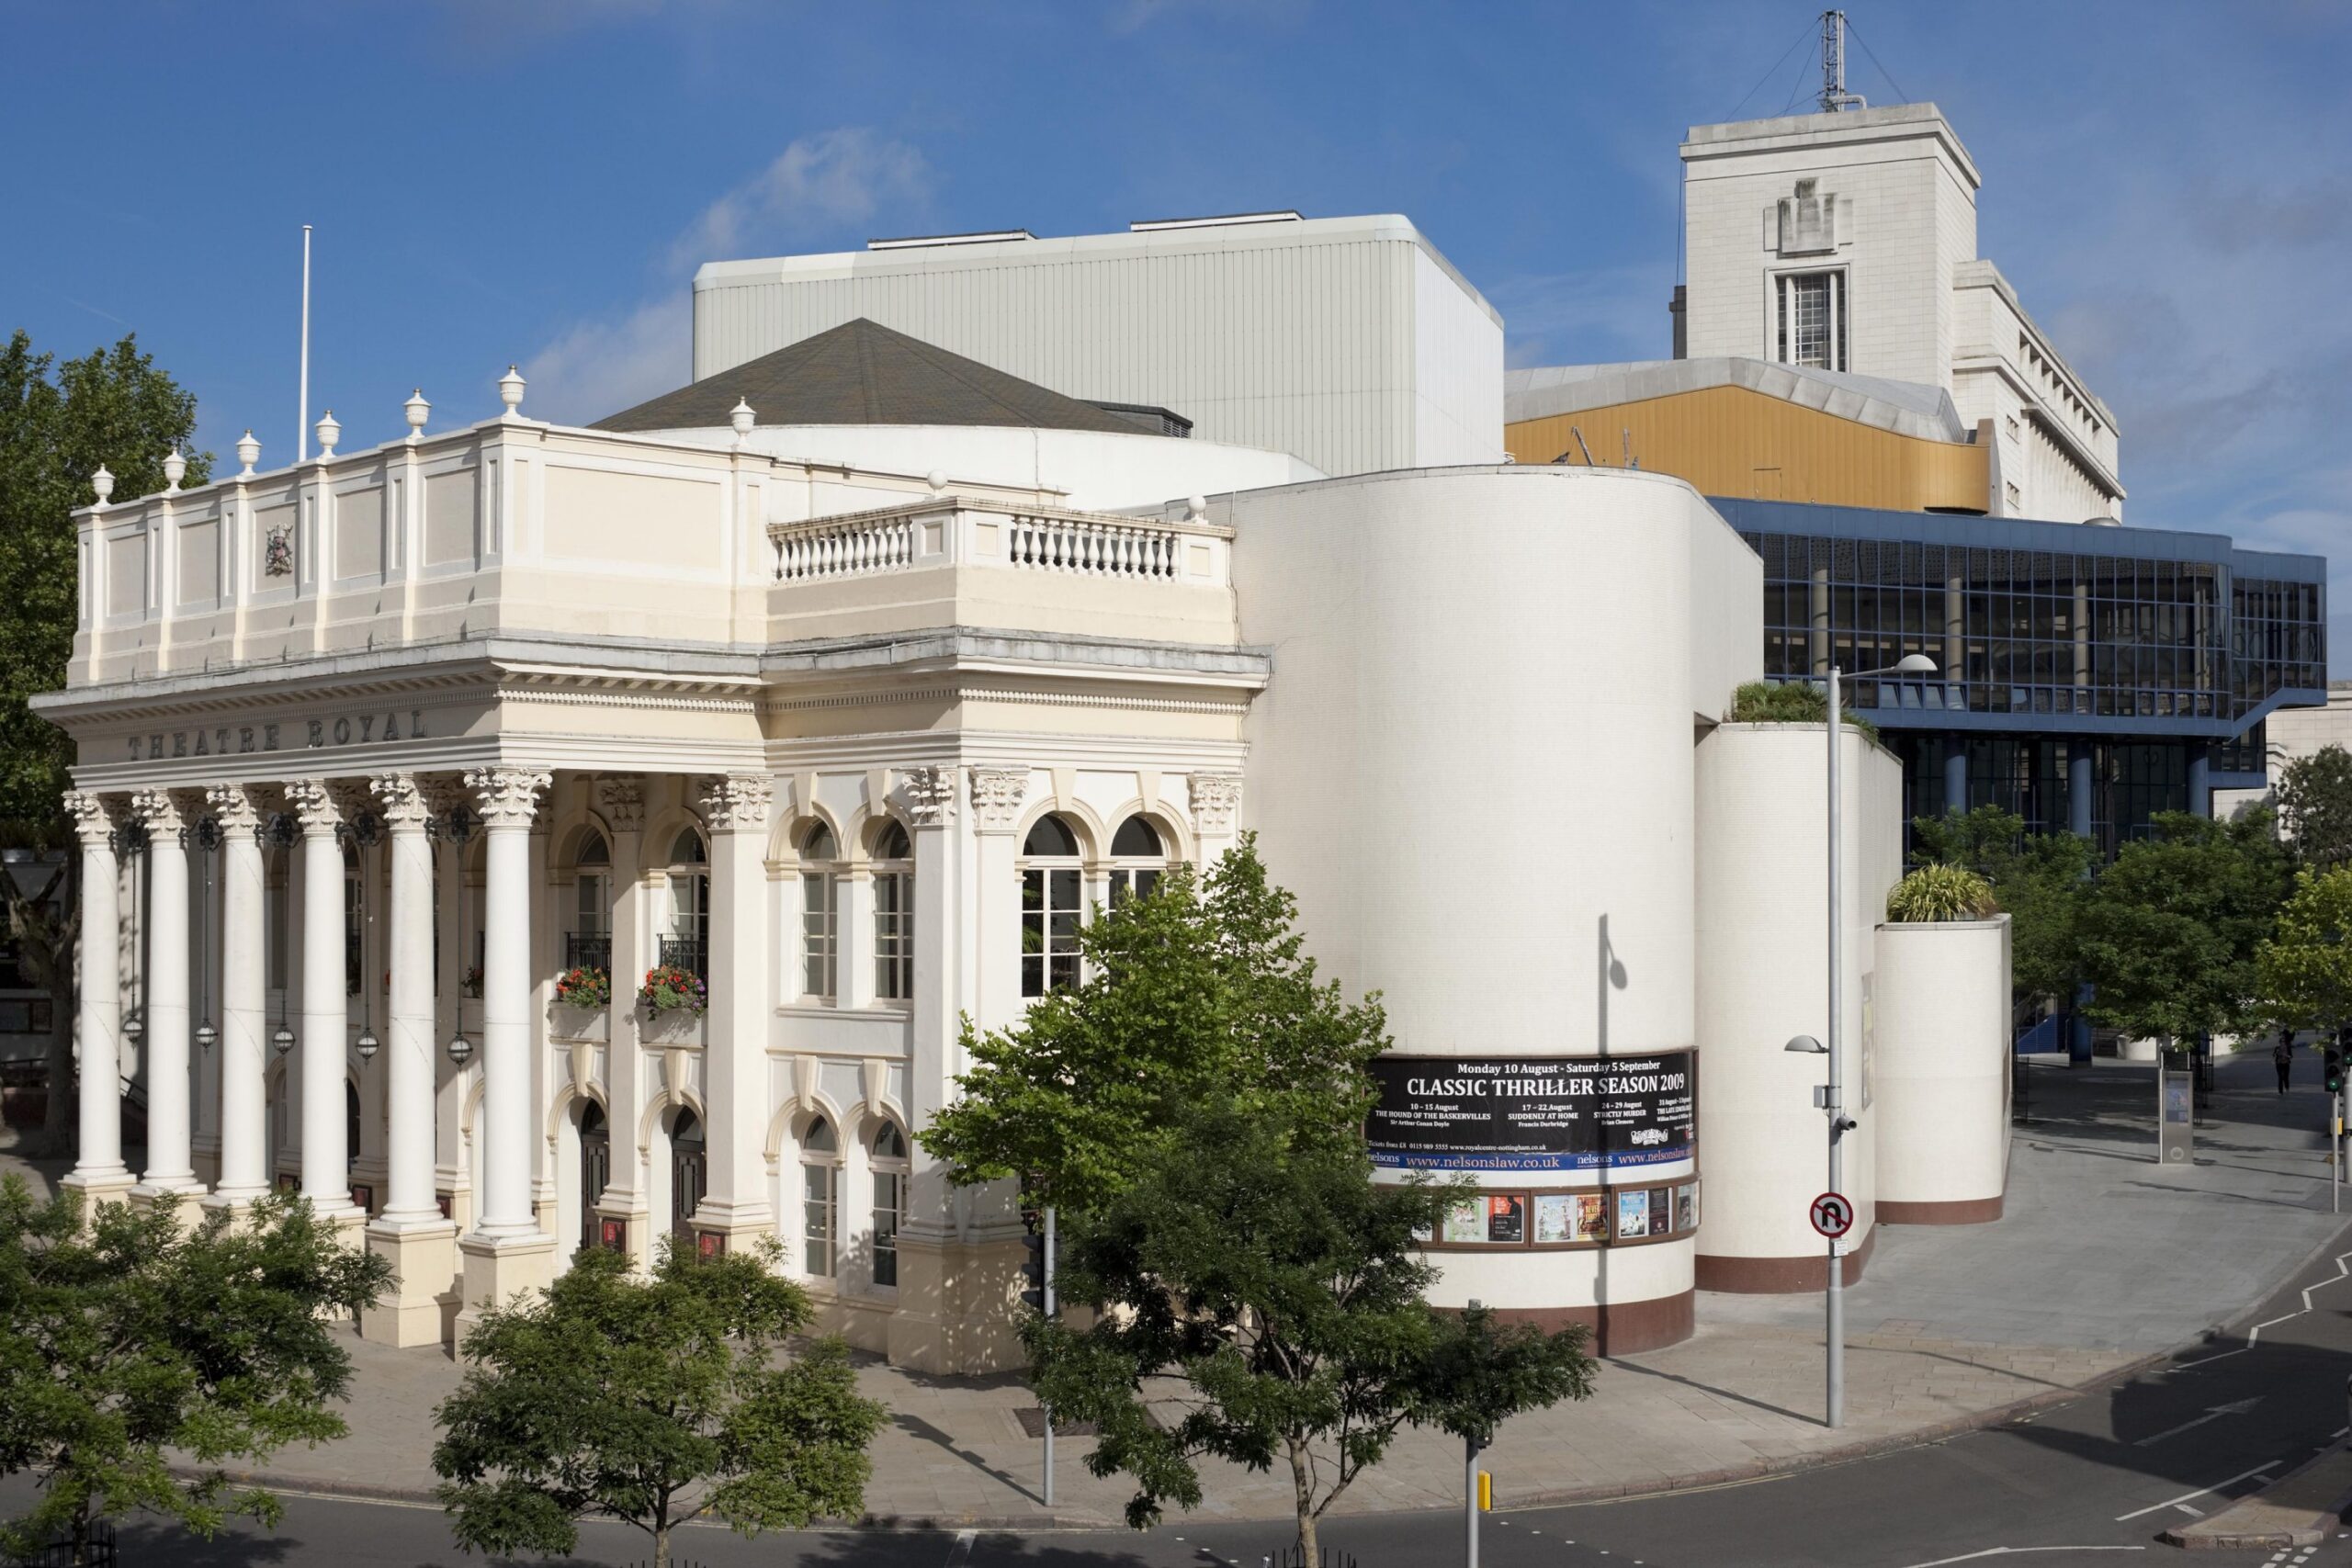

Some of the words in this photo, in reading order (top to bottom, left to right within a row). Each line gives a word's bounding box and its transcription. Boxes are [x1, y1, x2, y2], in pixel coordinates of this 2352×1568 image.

[129, 725, 280, 761] THEATRE
[307, 710, 427, 747] ROYAL
[1457, 1063, 1501, 1076] Monday
[1504, 1064, 1518, 1074] 10
[1521, 1064, 1558, 1076] August
[1566, 1062, 1610, 1075] Saturday
[1611, 1062, 1618, 1072] 5
[1619, 1060, 1661, 1073] September
[1407, 1078, 1487, 1096] CLASSIC
[1491, 1078, 1595, 1096] THRILLER
[1598, 1076, 1657, 1094] SEASON
[1660, 1073, 1685, 1091] 2009
[1434, 1103, 1459, 1111] August
[1623, 1101, 1642, 1110] August
[1593, 1111, 1623, 1119] STRICTLY
[1406, 1156, 1560, 1168] www.nelsonslaw.co.uk
[1577, 1154, 1613, 1165] nelsons
